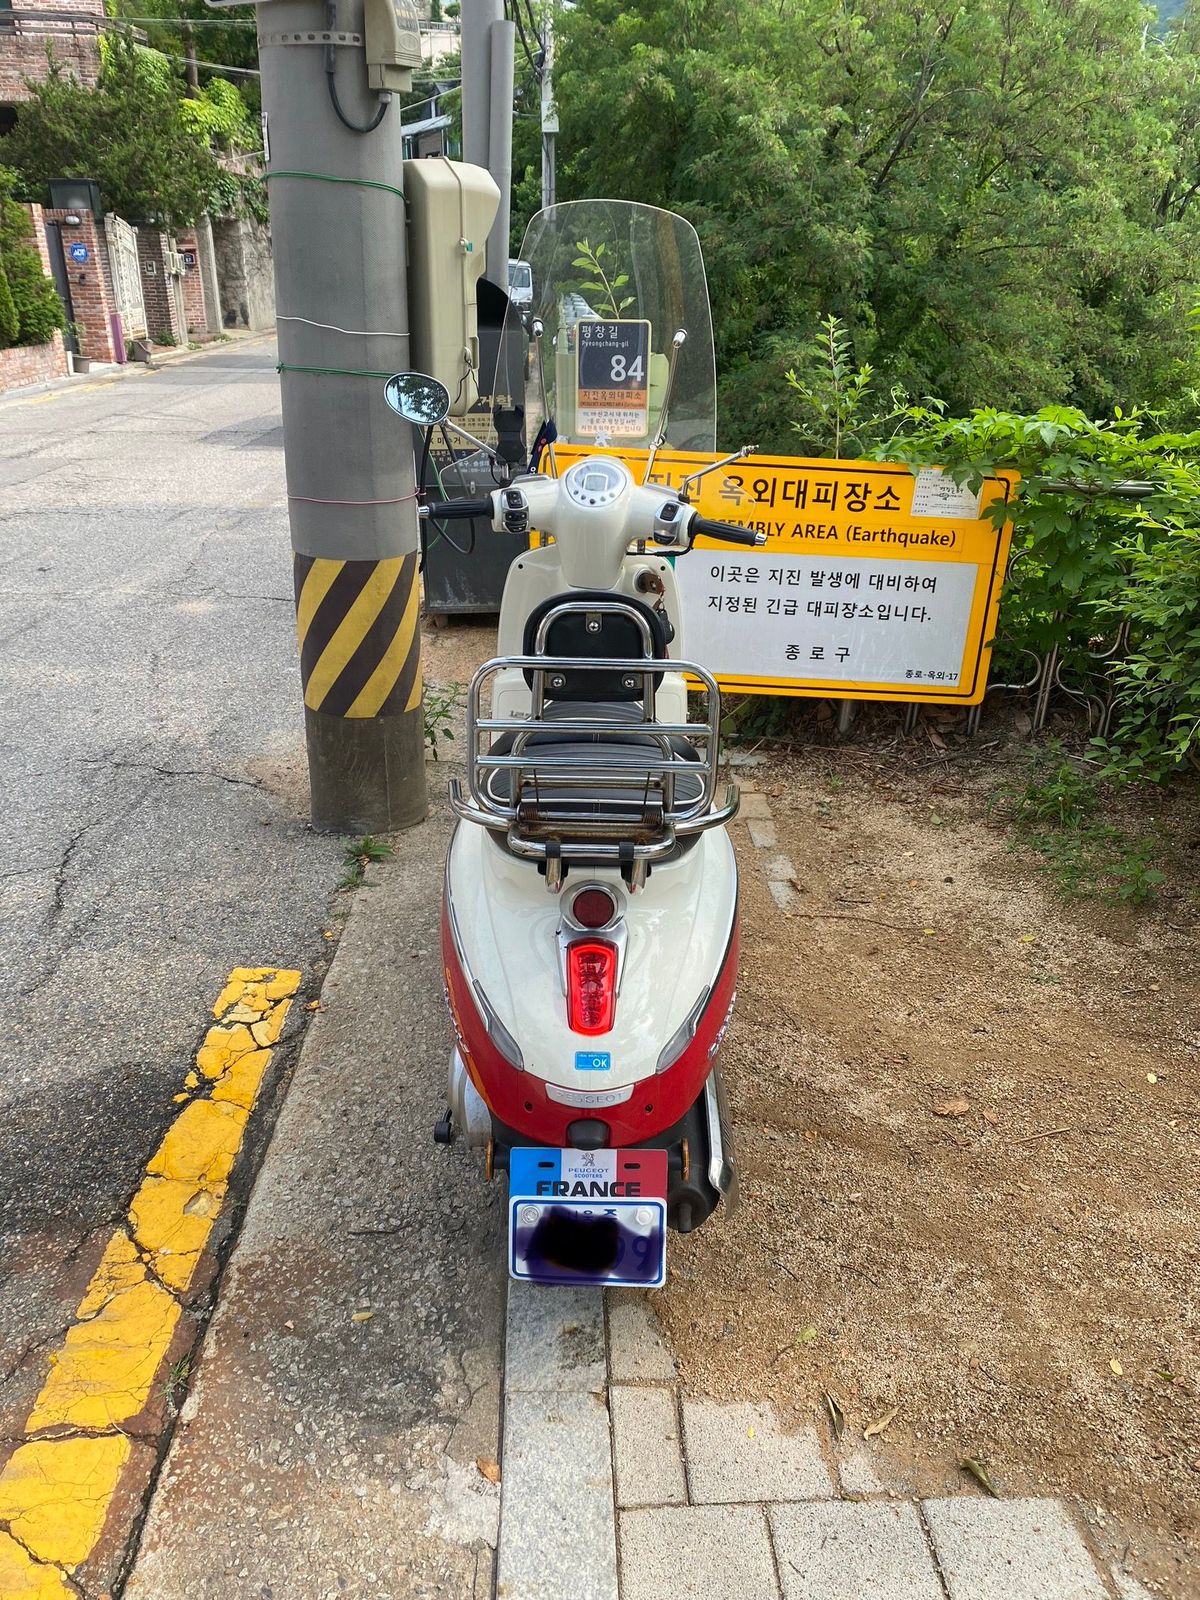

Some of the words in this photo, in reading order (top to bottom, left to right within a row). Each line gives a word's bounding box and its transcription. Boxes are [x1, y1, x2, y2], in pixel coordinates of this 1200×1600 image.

[581, 325, 618, 339] 평창길
[581, 340, 629, 348] Pyeongchang-gil
[610, 354, 644, 382] 84
[583, 390, 641, 401] 지진옥외대피소
[719, 474, 901, 514] 옥외대피장소
[791, 523, 839, 541] AREA
[846, 525, 957, 549] (Earthquake)
[711, 565, 760, 583] 이곳은
[768, 569, 801, 587] 지진
[810, 570, 861, 590] 발생에
[869, 573, 937, 593] 대비하여
[708, 595, 758, 615] 지정된
[767, 598, 799, 616] 긴급
[807, 600, 932, 623] 대피장소입니다.
[905, 669, 958, 681] 종로-옥외-17
[592, 1058, 607, 1068] OK
[537, 1181, 641, 1197] FRANCE
